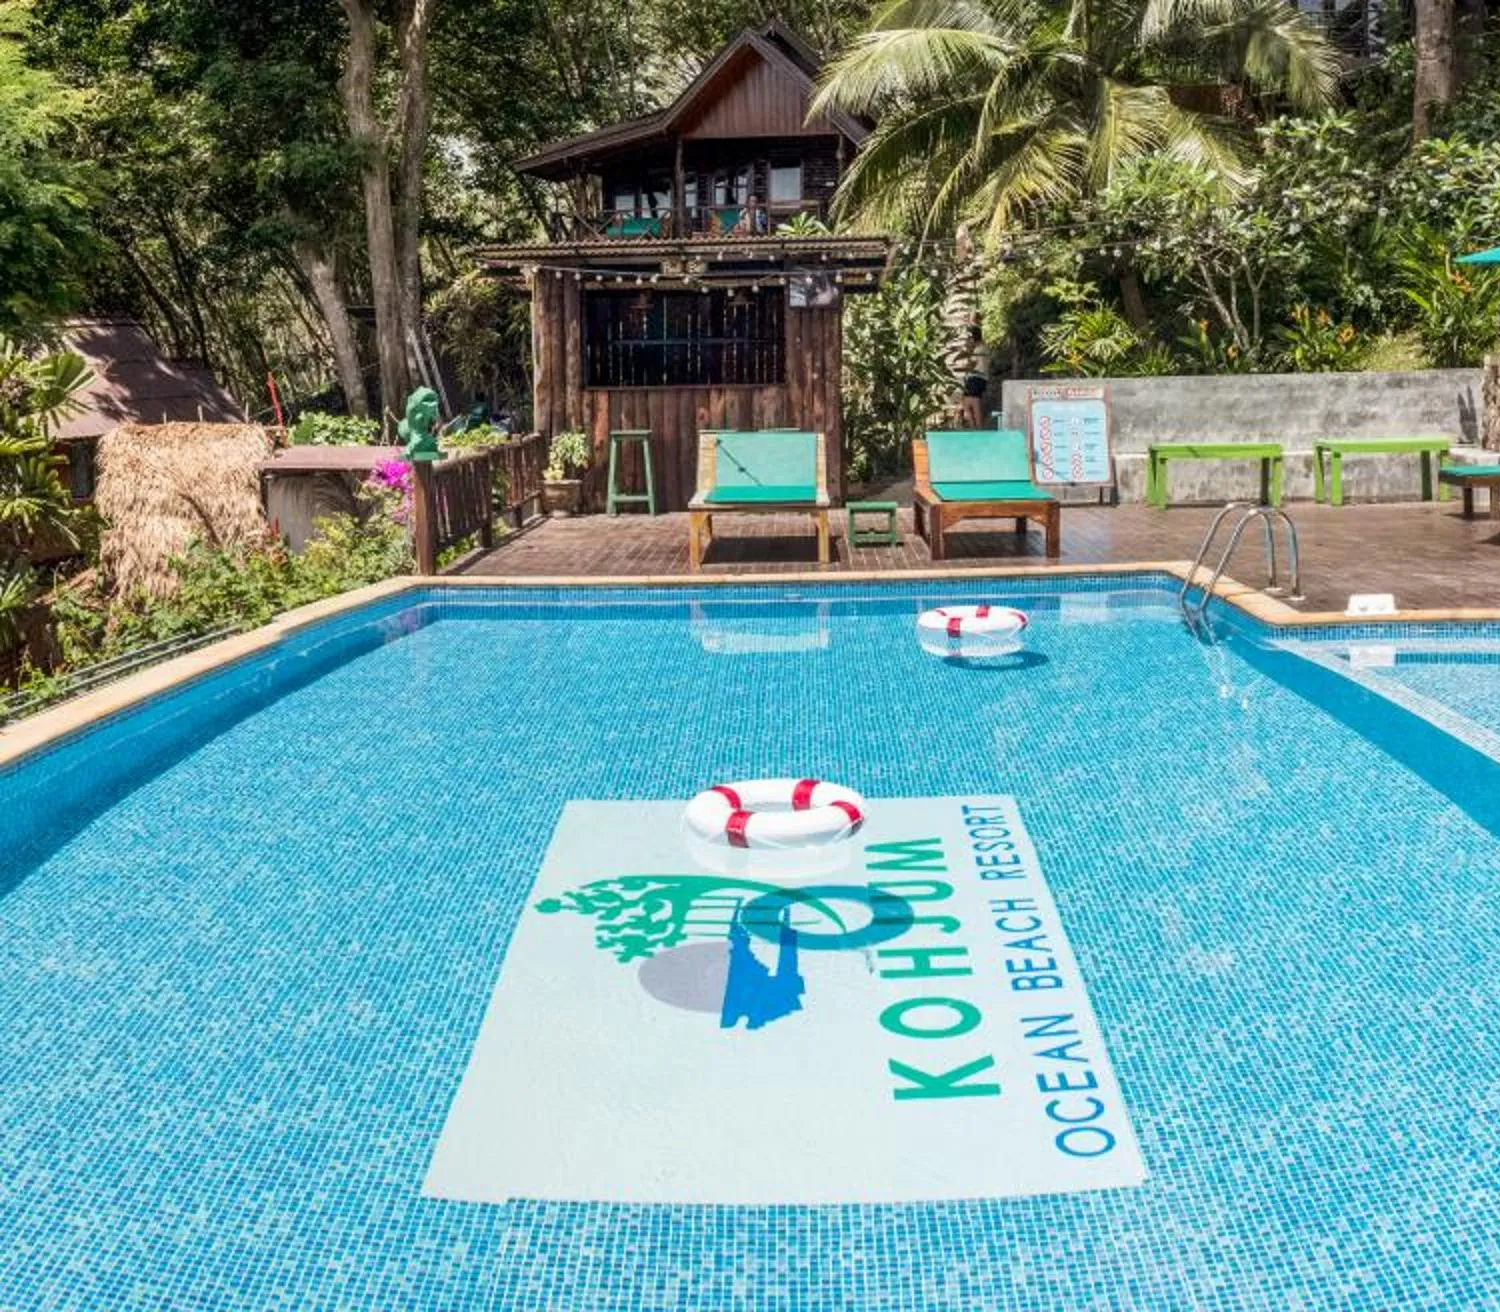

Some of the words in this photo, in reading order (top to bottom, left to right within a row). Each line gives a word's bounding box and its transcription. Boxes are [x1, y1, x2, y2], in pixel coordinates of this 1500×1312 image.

[961, 804, 1027, 881] RESORT
[987, 898, 1064, 991] BEACH
[1020, 1012, 1117, 1157] OCEAN
